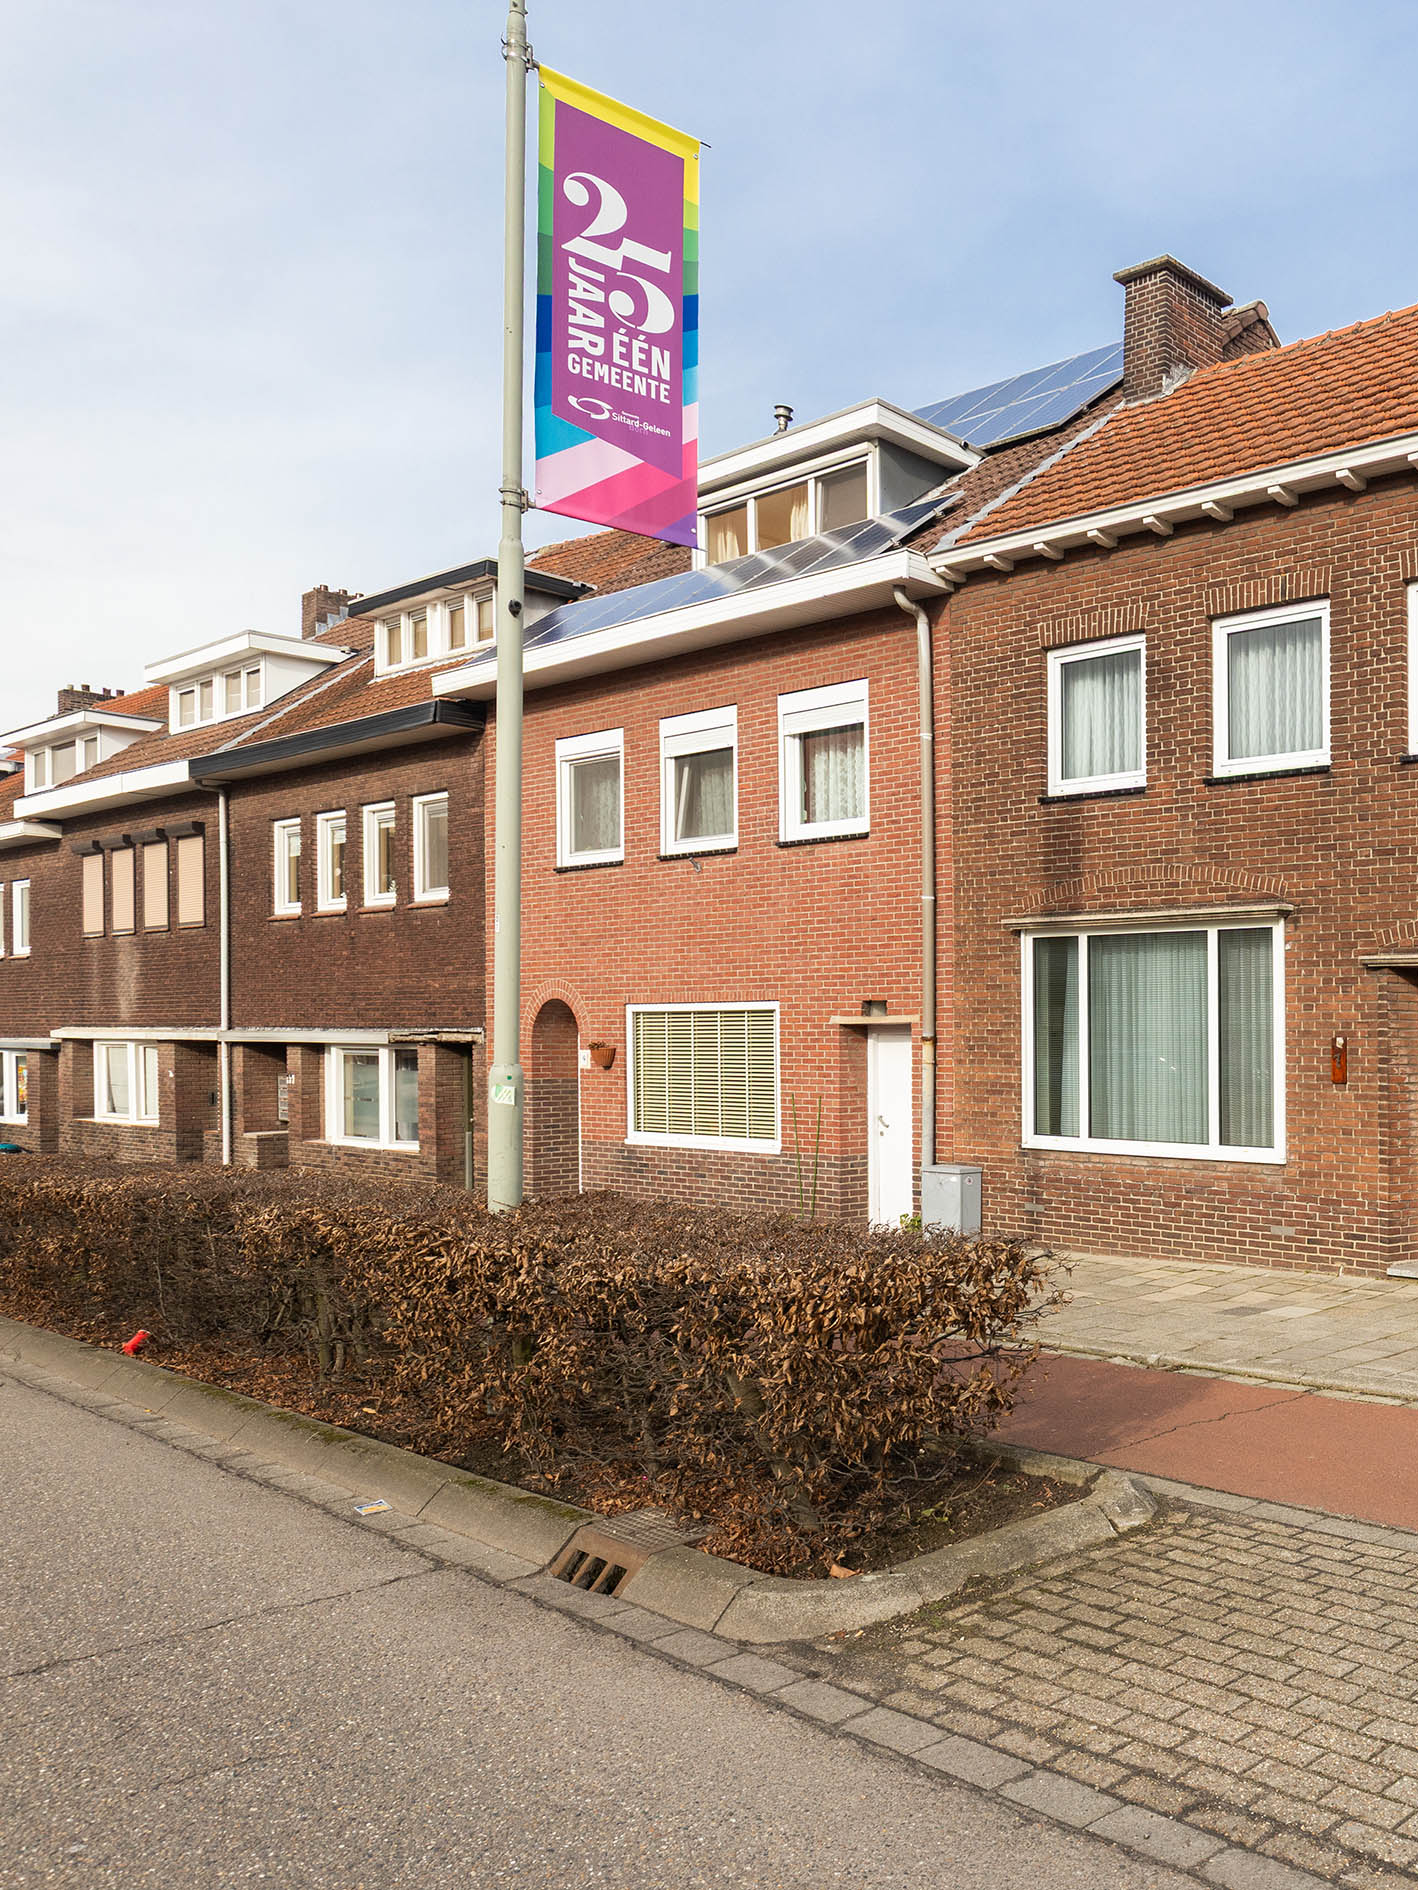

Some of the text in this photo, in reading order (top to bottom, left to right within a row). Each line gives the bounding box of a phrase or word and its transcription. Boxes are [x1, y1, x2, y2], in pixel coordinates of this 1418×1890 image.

[561, 172, 675, 334] 25
[568, 256, 605, 356] JAAR
[567, 353, 671, 404] GEMEENTE
[613, 327, 670, 381] ÉÉN
[611, 412, 671, 437] Sittard-Geleen
